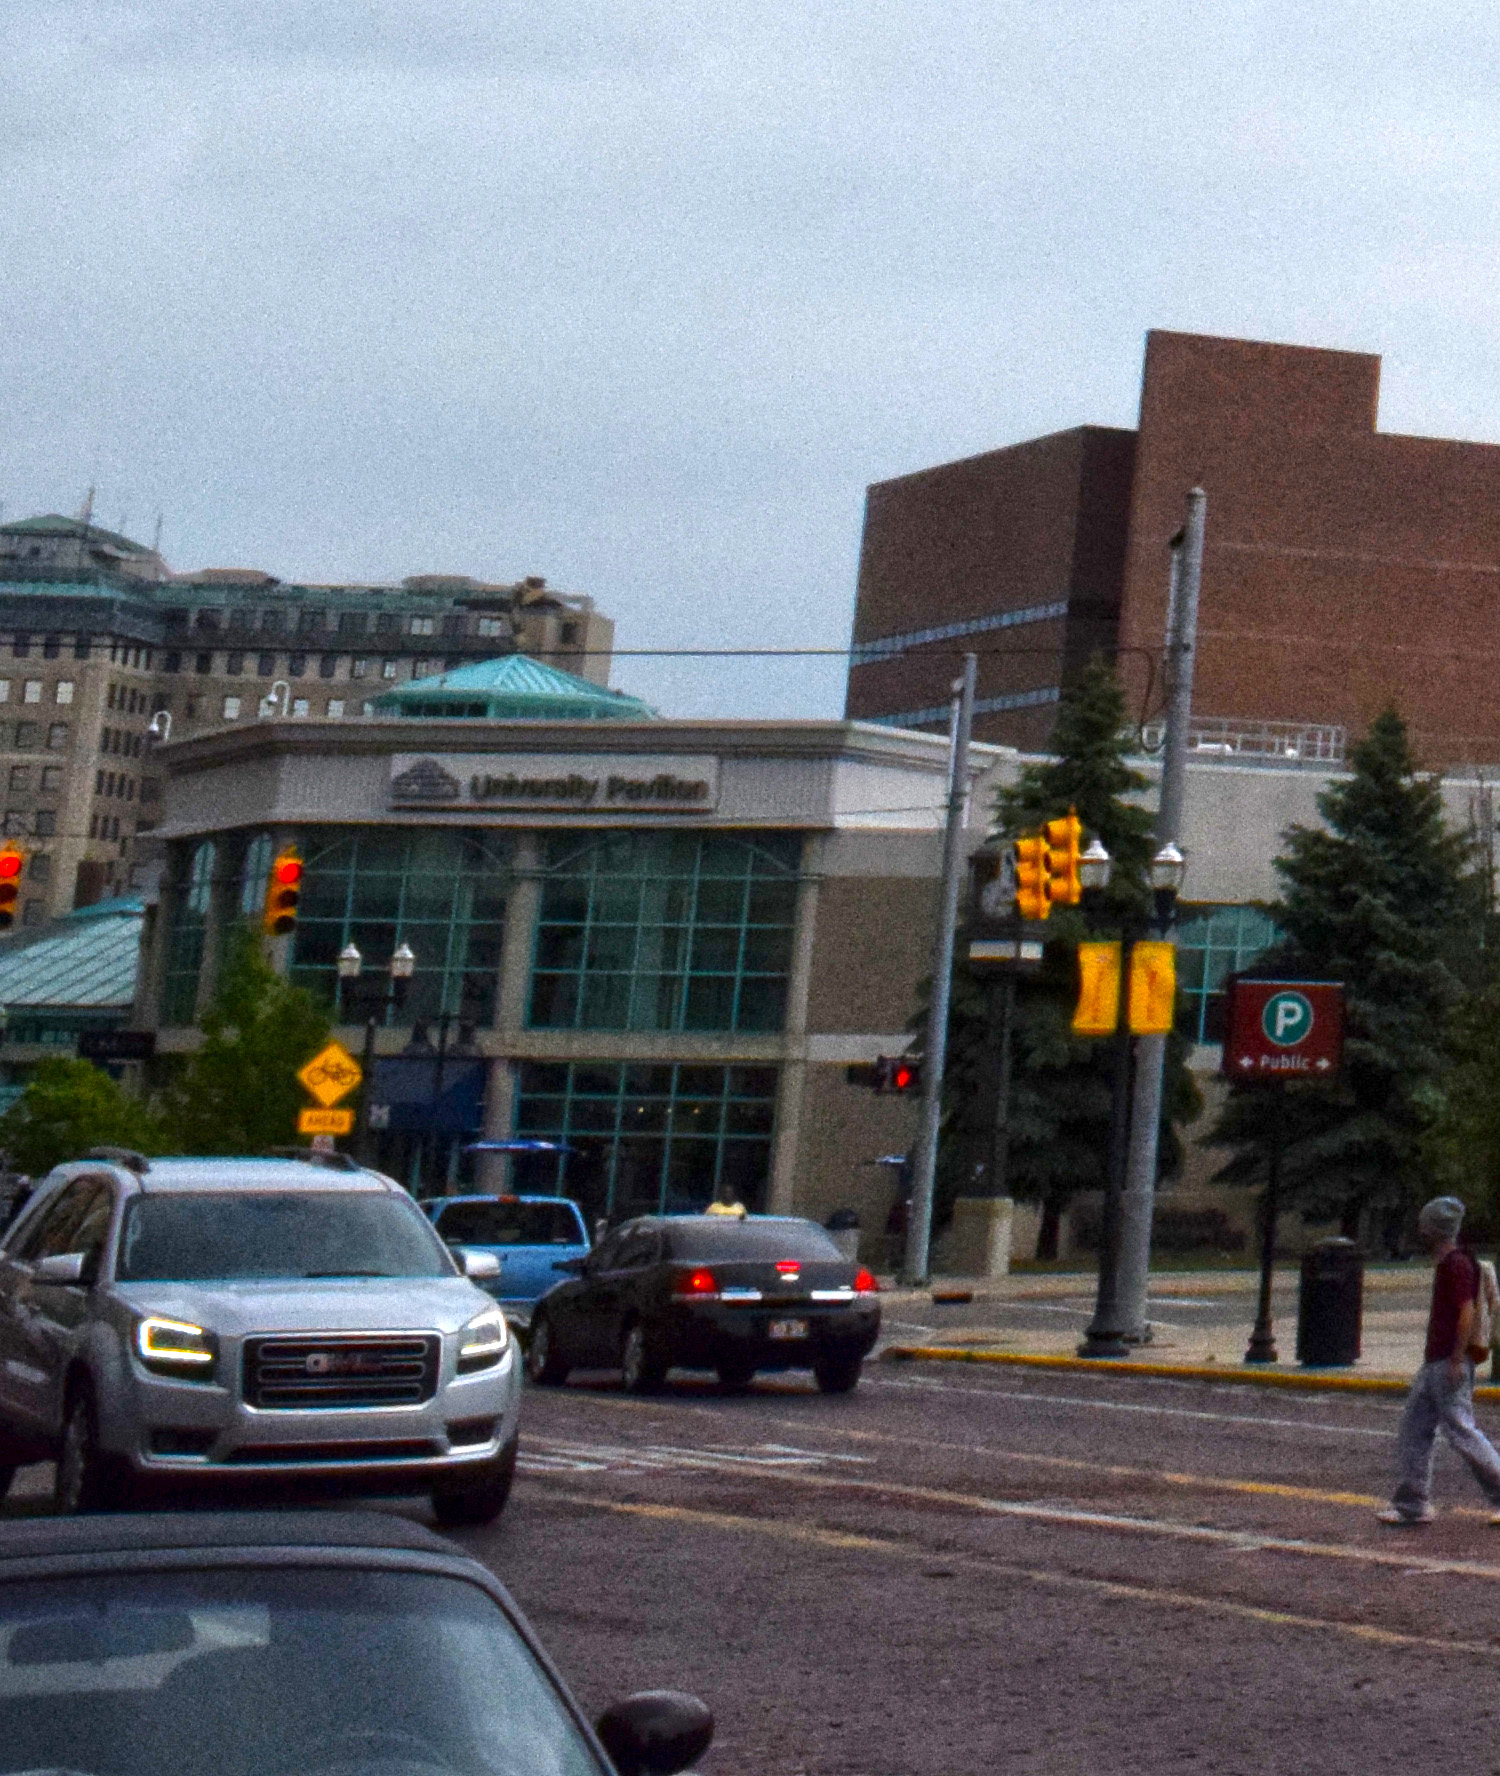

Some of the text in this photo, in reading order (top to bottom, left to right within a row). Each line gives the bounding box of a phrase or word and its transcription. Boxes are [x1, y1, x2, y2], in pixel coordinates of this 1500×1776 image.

[469, 772, 710, 805] University Pavilion
[1276, 1000, 1304, 1037] P
[1260, 1054, 1310, 1069] Public
